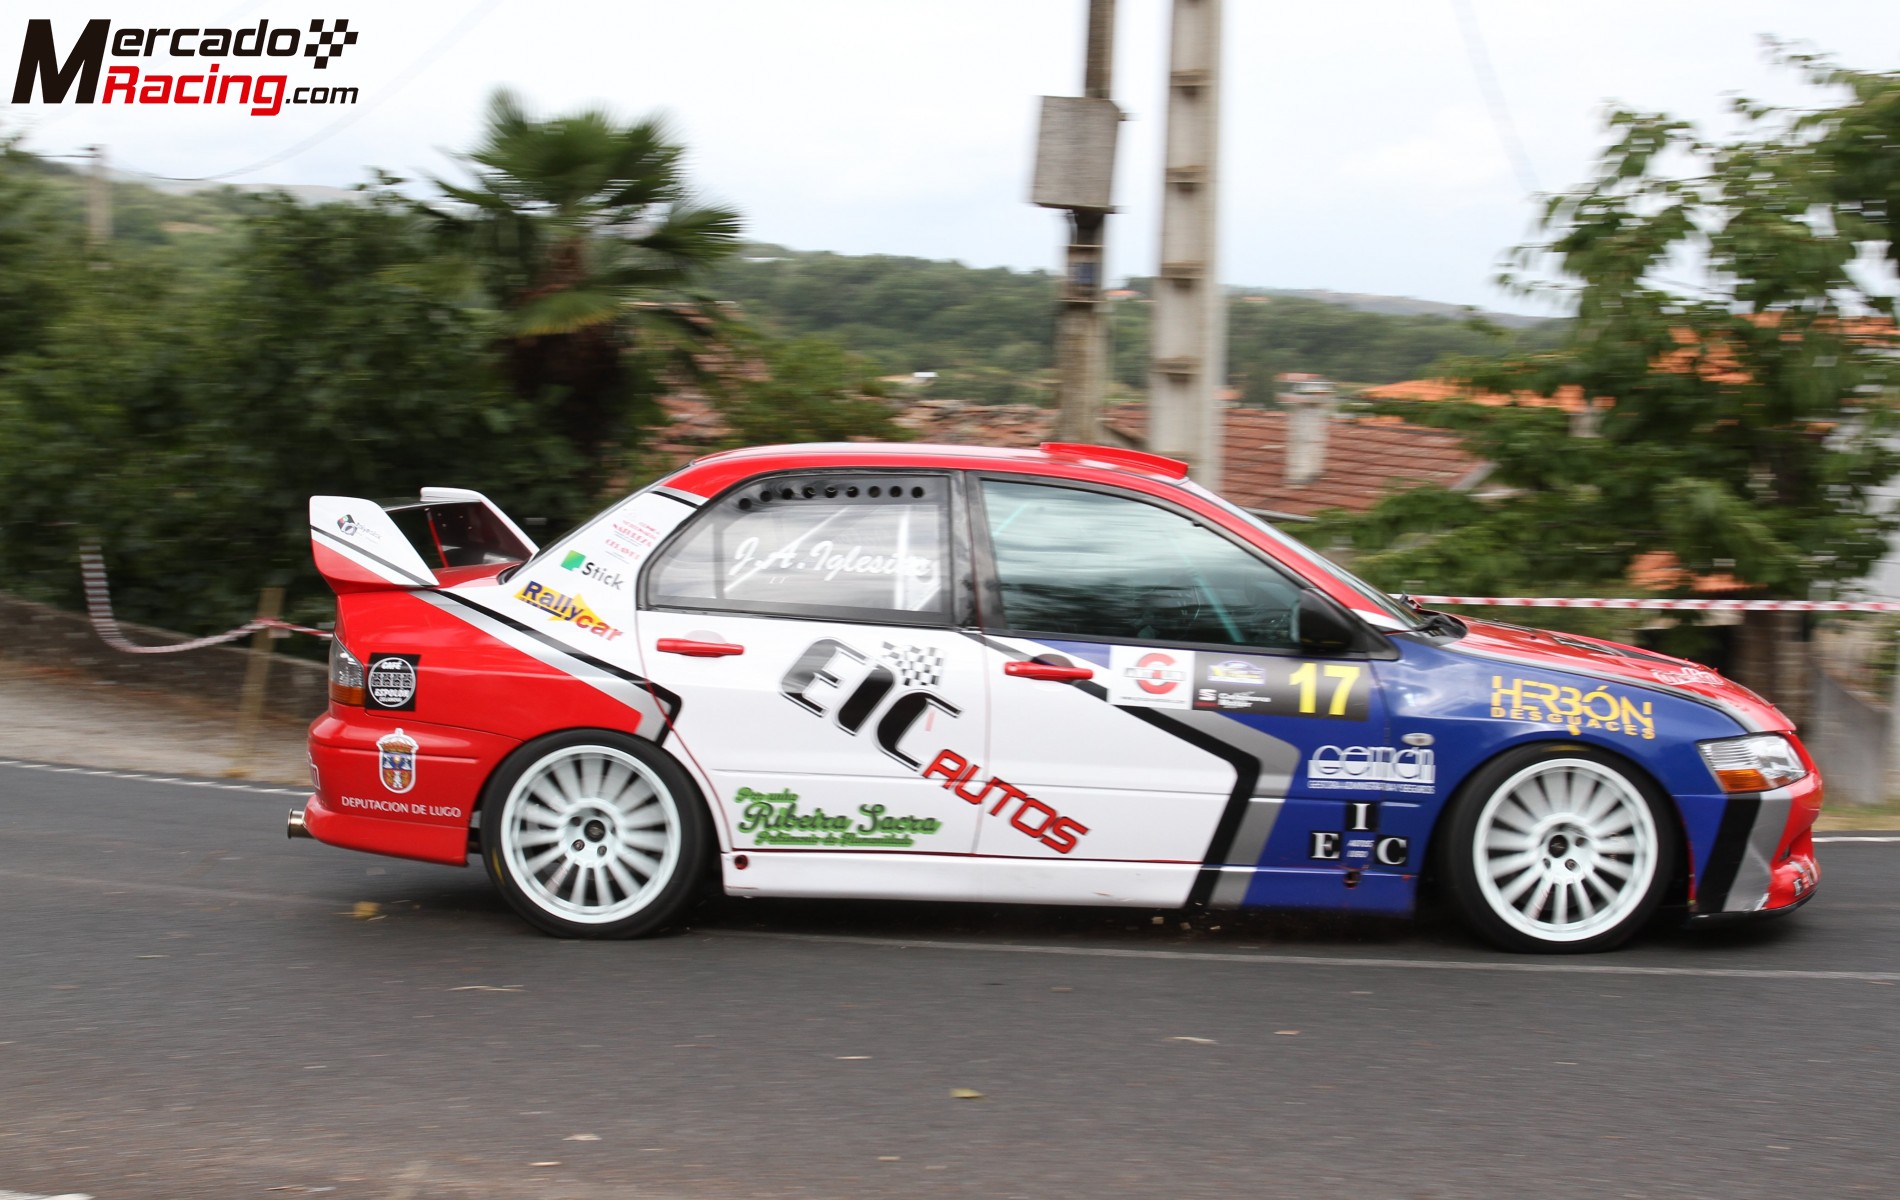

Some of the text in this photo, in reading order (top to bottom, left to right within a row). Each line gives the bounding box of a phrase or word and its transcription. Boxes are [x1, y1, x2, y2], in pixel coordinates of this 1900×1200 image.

[581, 562, 624, 590] Stick
[523, 580, 624, 641] Rallycar
[1288, 662, 1361, 716] 17
[1490, 706, 1656, 740] DESGUACES
[341, 795, 462, 818] DEPUTACION DE LUGO
[738, 802, 943, 834] Ribeira Sacra
[921, 748, 1090, 855] AUTOS
